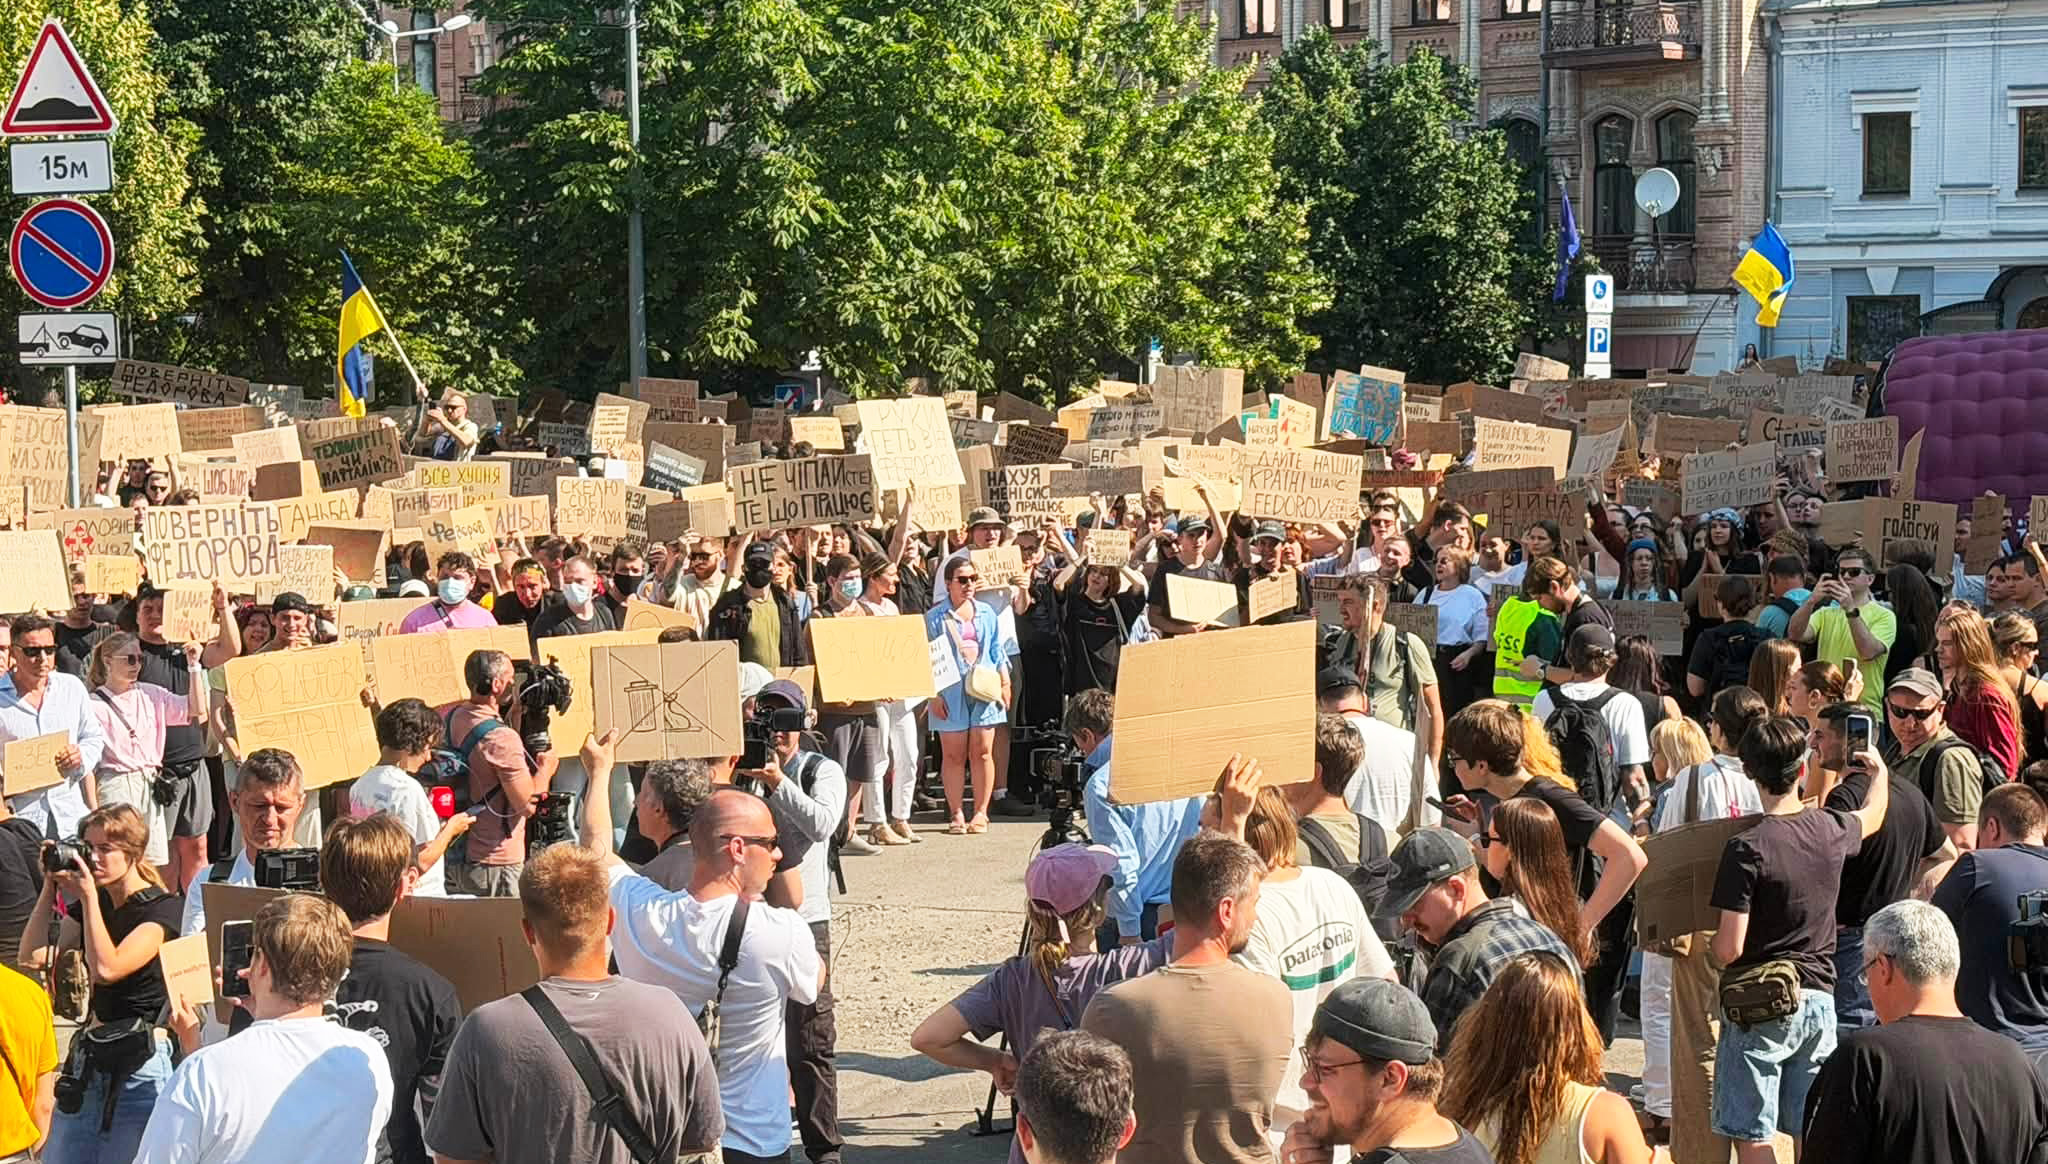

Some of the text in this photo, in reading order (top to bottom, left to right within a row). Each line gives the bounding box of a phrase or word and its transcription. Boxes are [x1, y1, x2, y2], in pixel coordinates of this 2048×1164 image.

[120, 374, 226, 406] ФЕДОРОВА
[122, 364, 237, 393] ПОВЕРНІТЬ
[1832, 421, 1893, 441] ПОВЕРНІТЬ
[740, 464, 777, 496] НЕ
[986, 468, 1041, 488] НАХУЯ
[1838, 463, 1887, 478] ОБОРОНИ
[988, 486, 1022, 502] МЕНІ
[1015, 500, 1065, 514] ПРАЦЮЄ
[1254, 493, 1332, 520] FEDOROV
[148, 503, 279, 541] ПОВЕРНІТЬ
[277, 498, 352, 533] ГАНЬБА
[736, 491, 873, 529] ТЕ ЩО ПРАЦЮЄ
[1902, 502, 1921, 521] ВР
[1882, 517, 1940, 542] ГОЛОСУЙ
[149, 534, 281, 585] ФЕДОРОВА
[1283, 929, 1354, 973] patagonia
